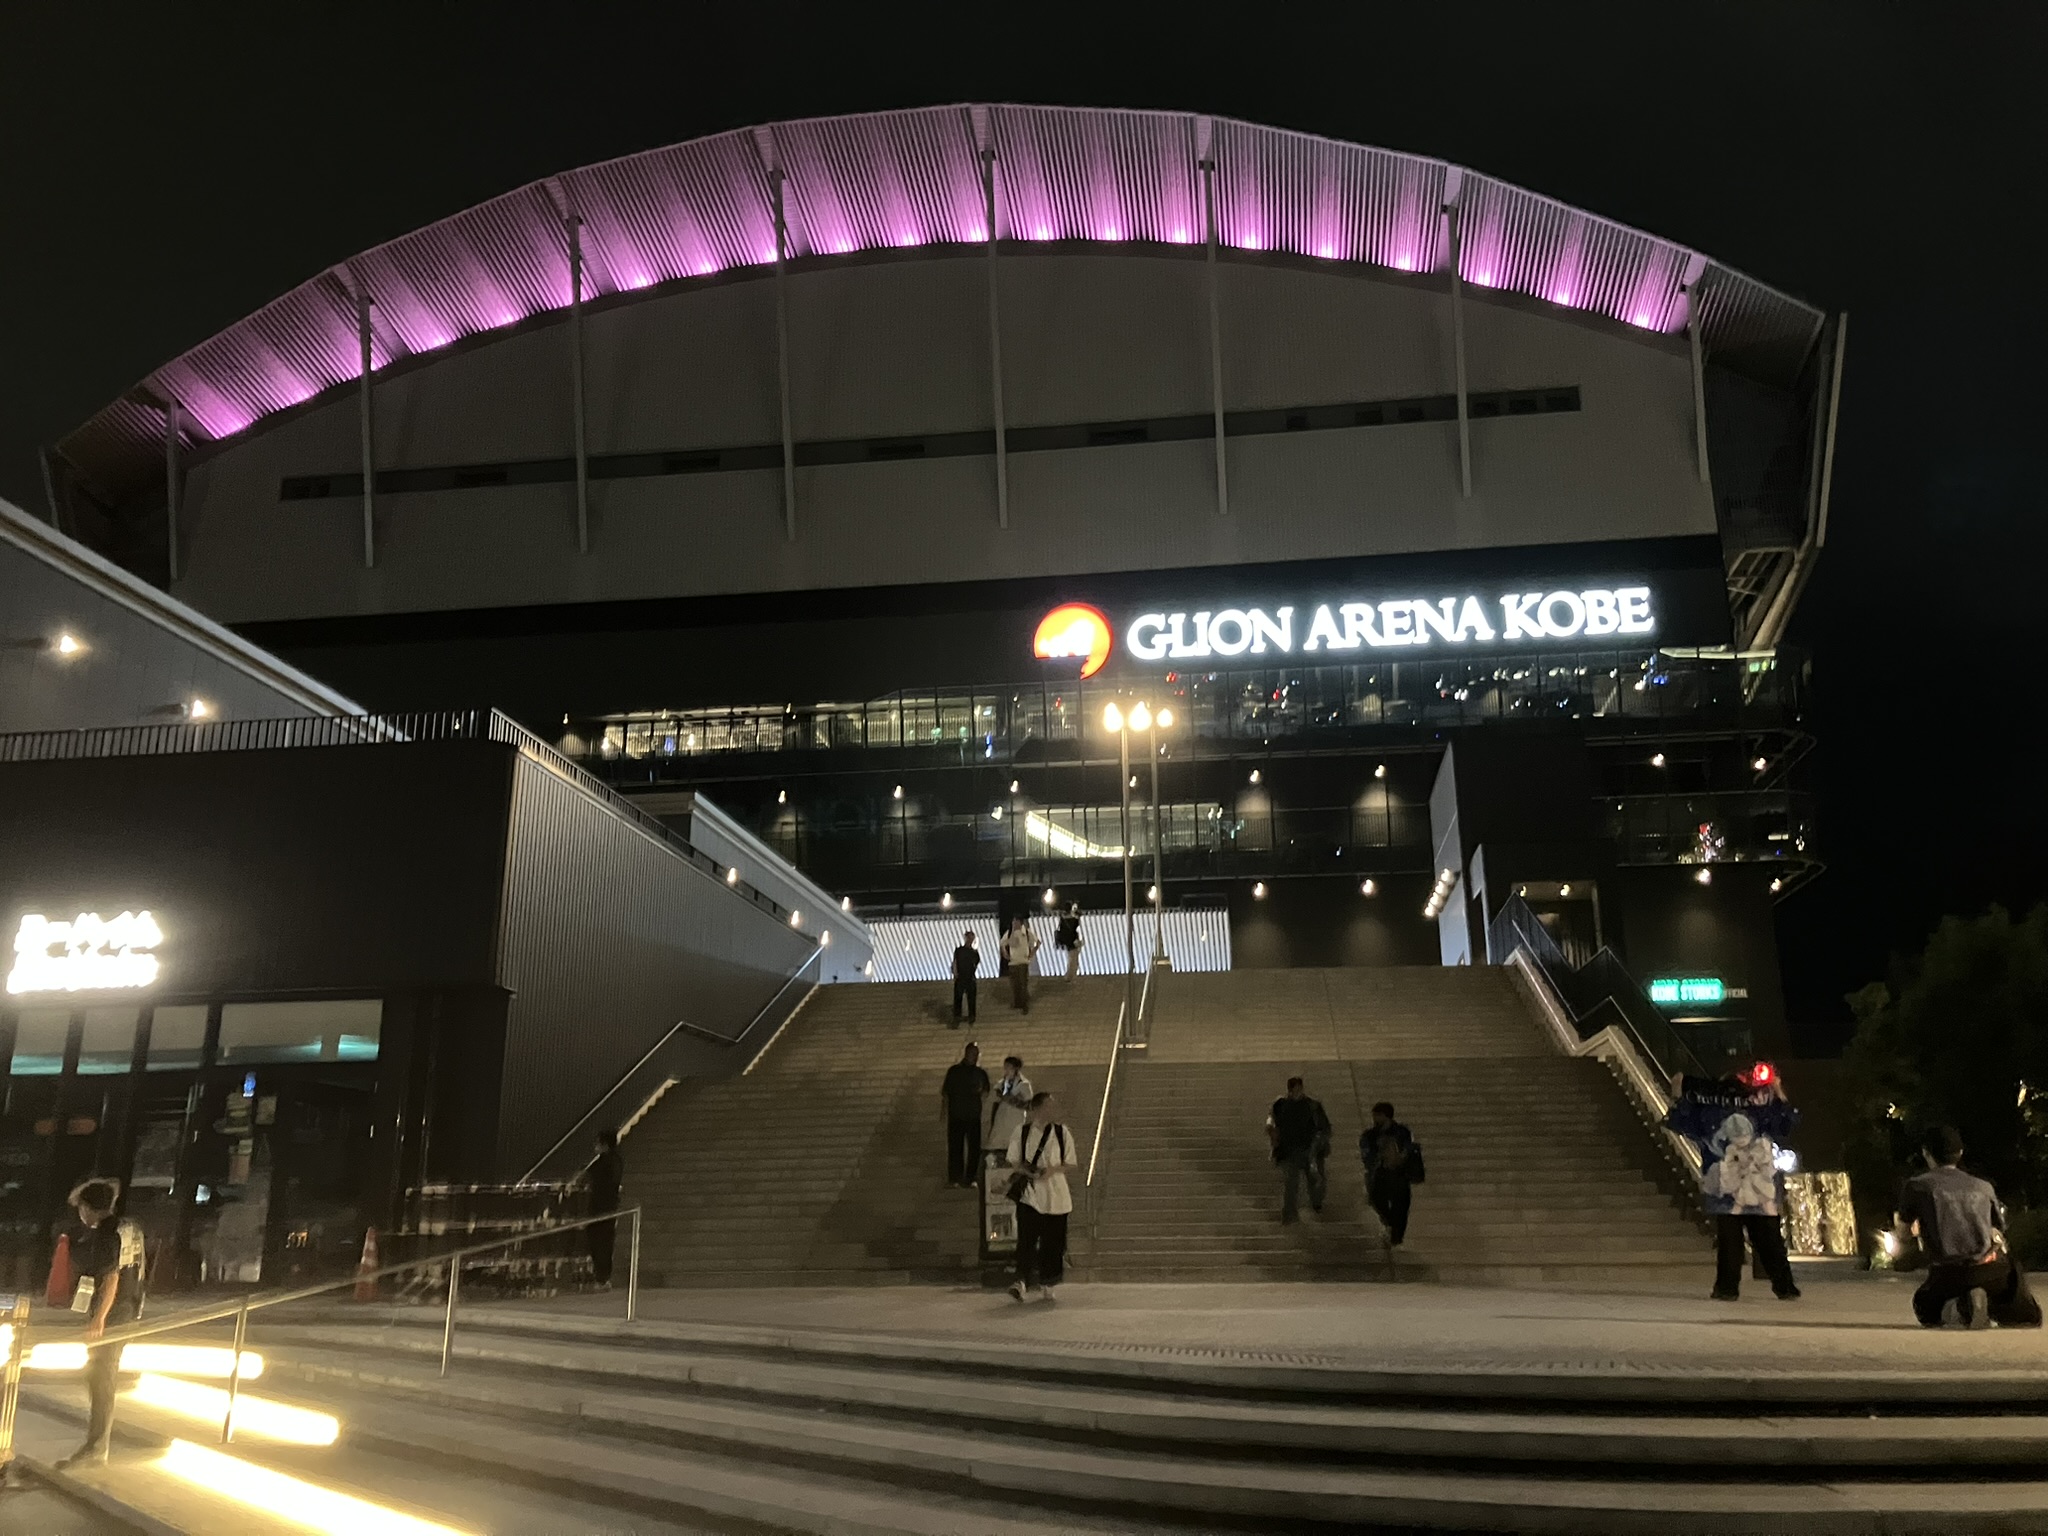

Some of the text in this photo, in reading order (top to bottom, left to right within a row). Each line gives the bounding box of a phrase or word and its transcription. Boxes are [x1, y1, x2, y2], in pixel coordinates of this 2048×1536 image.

[1126, 587, 1655, 660] GLION ARENA KOBE
